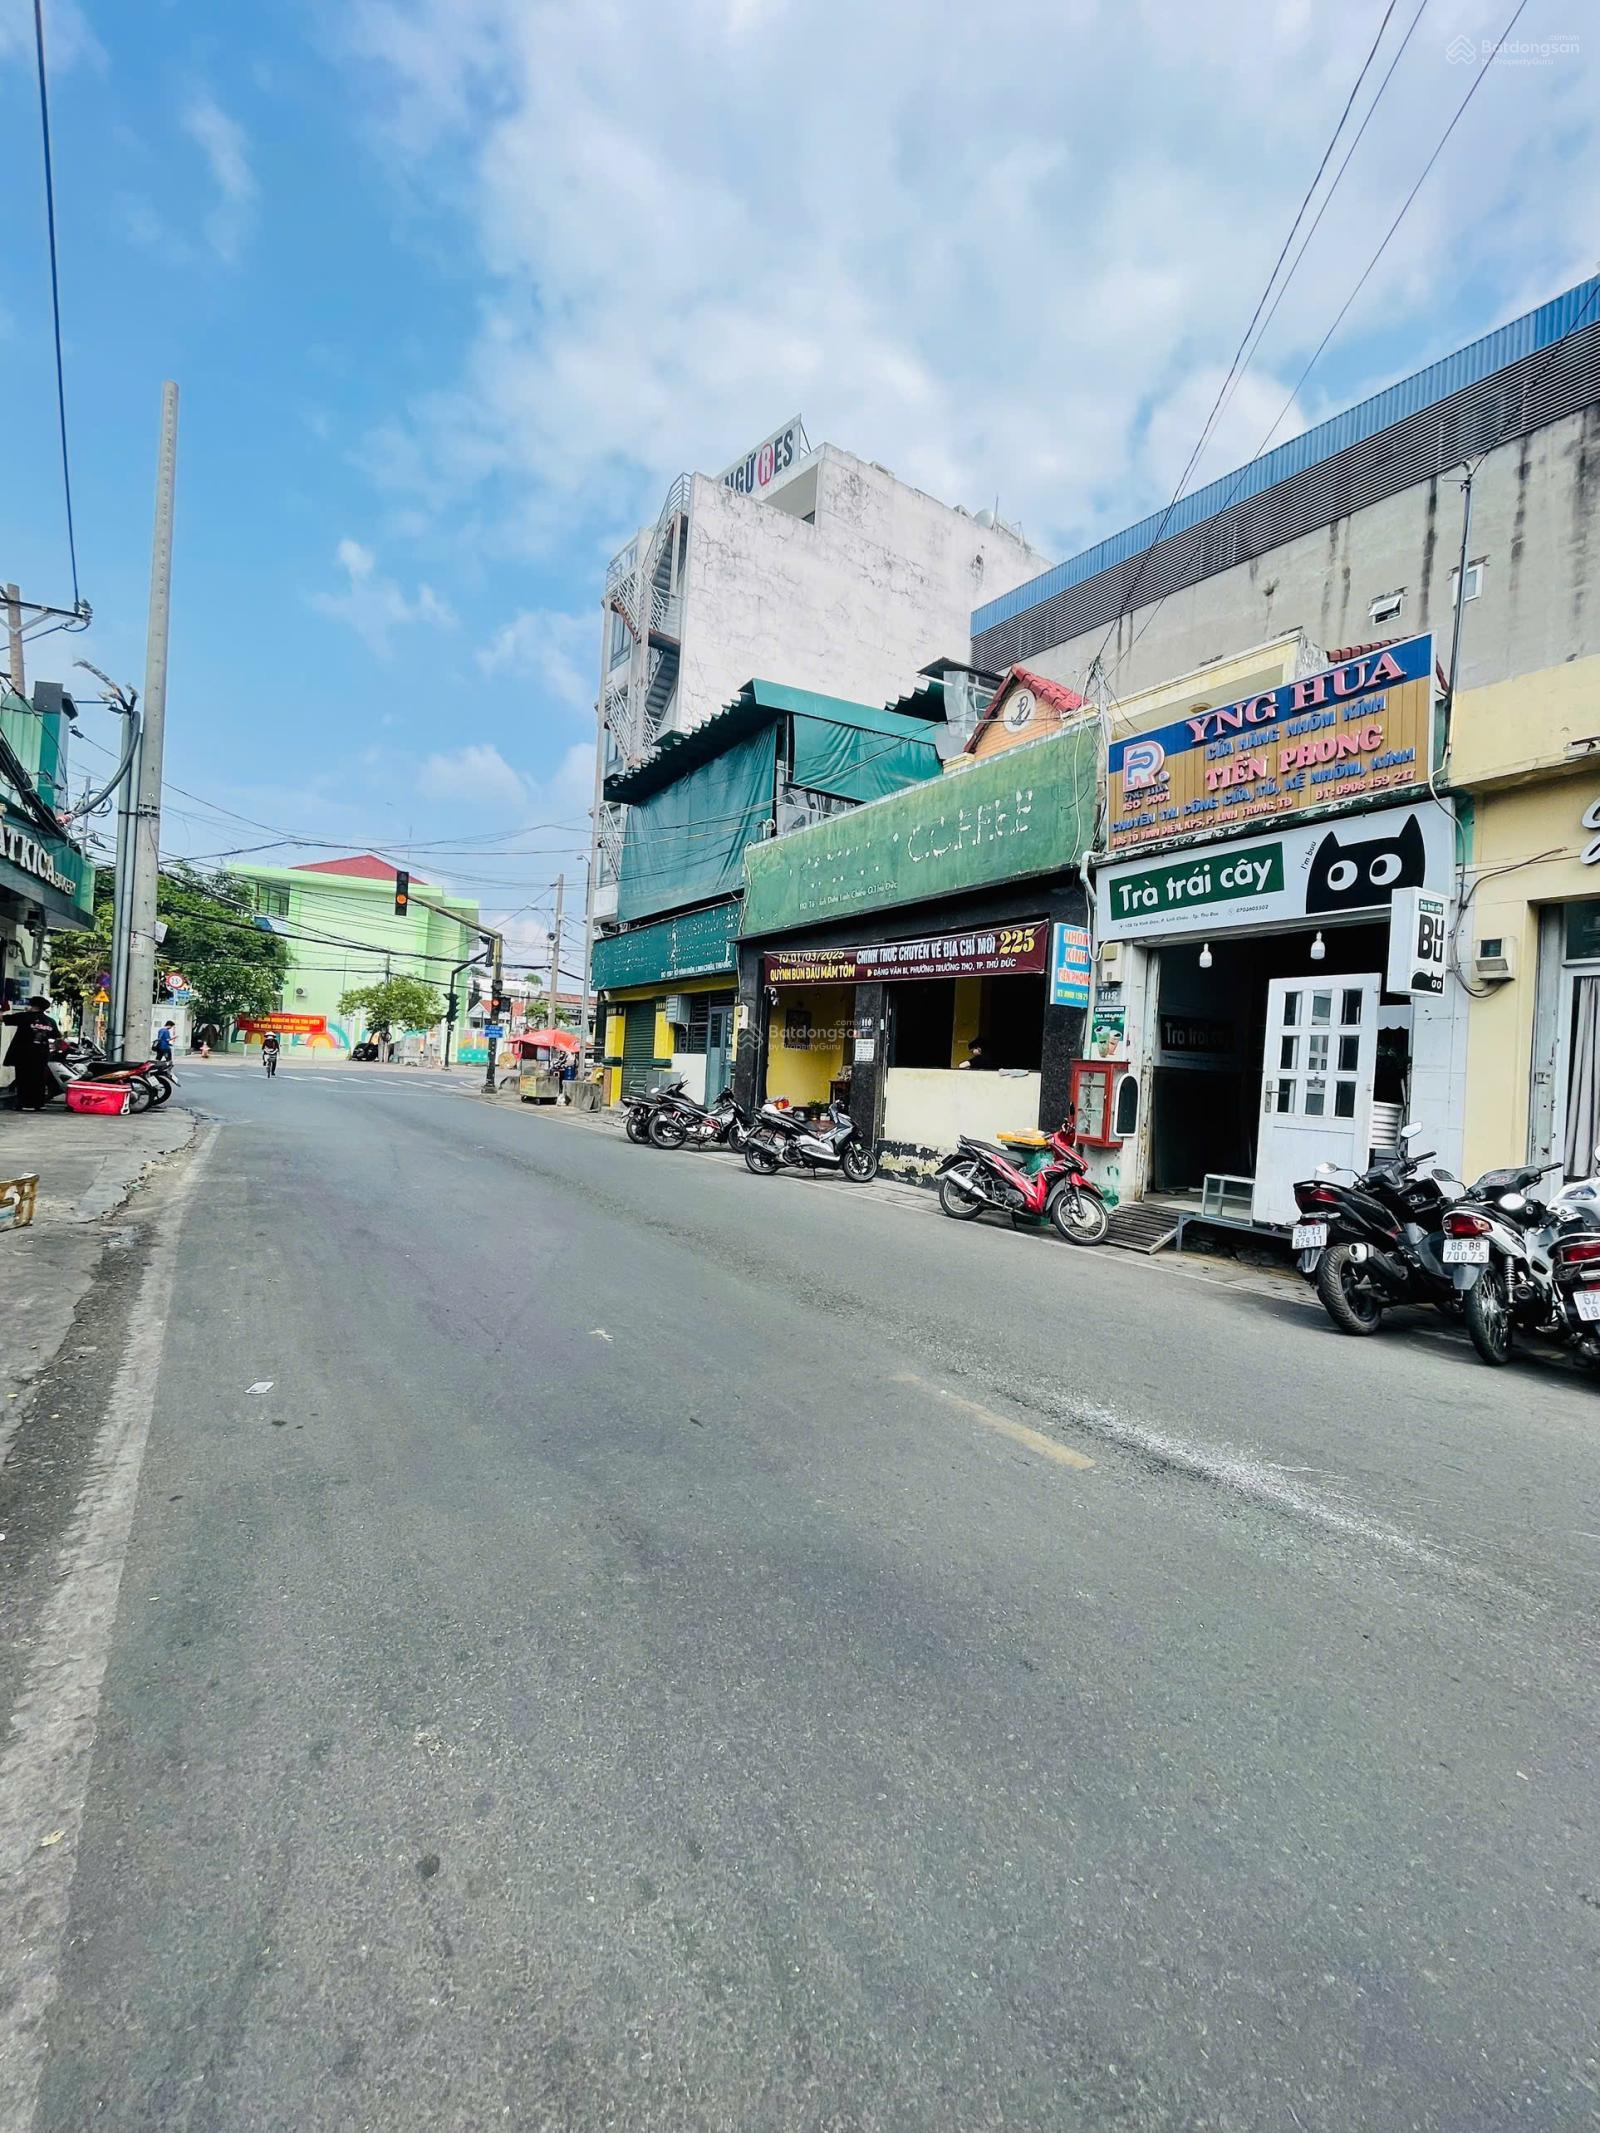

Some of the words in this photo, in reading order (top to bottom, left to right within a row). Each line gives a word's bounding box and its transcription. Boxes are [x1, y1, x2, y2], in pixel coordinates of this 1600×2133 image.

[1186, 694, 1279, 743] YNG
[1290, 651, 1408, 712] HUA
[1206, 737, 1234, 761] CỬA
[1238, 728, 1280, 750] HÀNG
[1286, 711, 1336, 738] NHÔM
[1343, 695, 1387, 721] KÍNH
[1279, 724, 1384, 773] PHONG
[1111, 811, 1156, 833] CHUYÊN
[1160, 807, 1179, 822] THI
[1183, 798, 1219, 816] CÔNG
[1370, 746, 1416, 771] KÍNH
[1123, 800, 1140, 812] ISO
[1146, 792, 1171, 806] 9001
[1218, 808, 1238, 823] LINH
[1336, 780, 1366, 796] 0908
[1369, 774, 1390, 789] 159
[1118, 880, 1159, 913] Trà
[1166, 864, 1212, 901] trái
[1219, 858, 1273, 891] cây
[899, 941, 930, 961] CHUYỂN
[943, 939, 958, 961] ĐỊA
[977, 932, 996, 955] MỚI
[999, 928, 1035, 955] 225
[769, 966, 791, 982] QUỲNH
[791, 964, 805, 981] BÚN
[806, 963, 820, 983] ĐẬU
[821, 960, 838, 979] MẮM
[839, 961, 856, 978] TÔM
[890, 965, 901, 975] VĂN
[976, 960, 985, 970] TP.
[986, 957, 999, 969] THỦ
[1000, 957, 1017, 968] ĐỨC
[1100, 991, 1119, 1001] 108
[1446, 1251, 1485, 1261] 700.75
